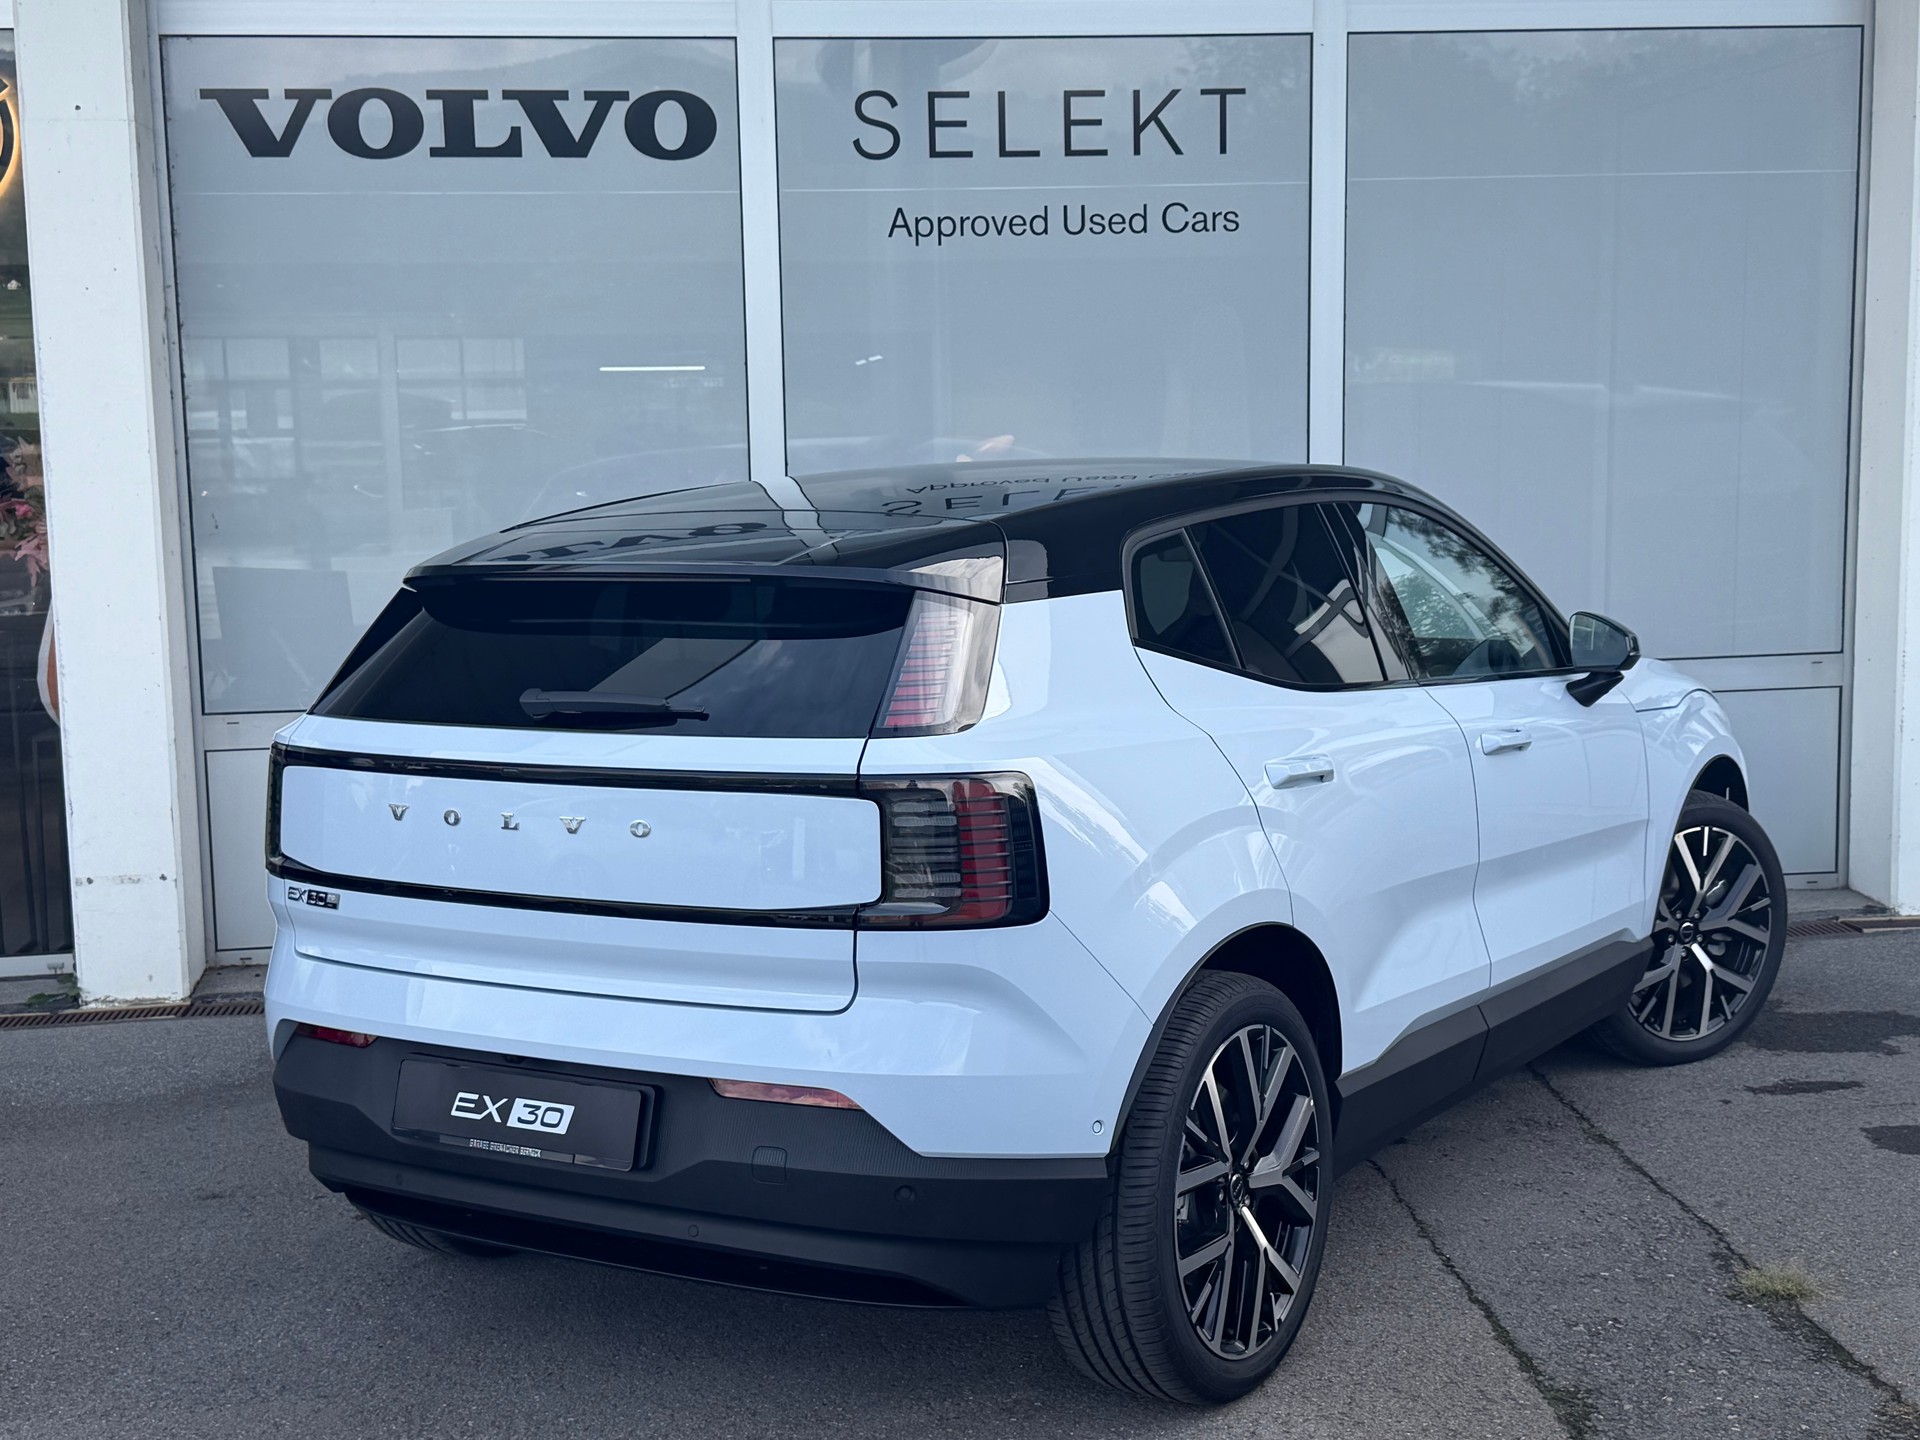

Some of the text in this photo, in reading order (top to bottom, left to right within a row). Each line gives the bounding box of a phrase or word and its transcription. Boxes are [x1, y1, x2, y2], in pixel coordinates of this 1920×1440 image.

[200, 88, 718, 161] VOLVO
[852, 88, 1247, 160] SELEKT
[888, 202, 1240, 247] Approved Used Cars
[388, 803, 651, 838] VOLVO
